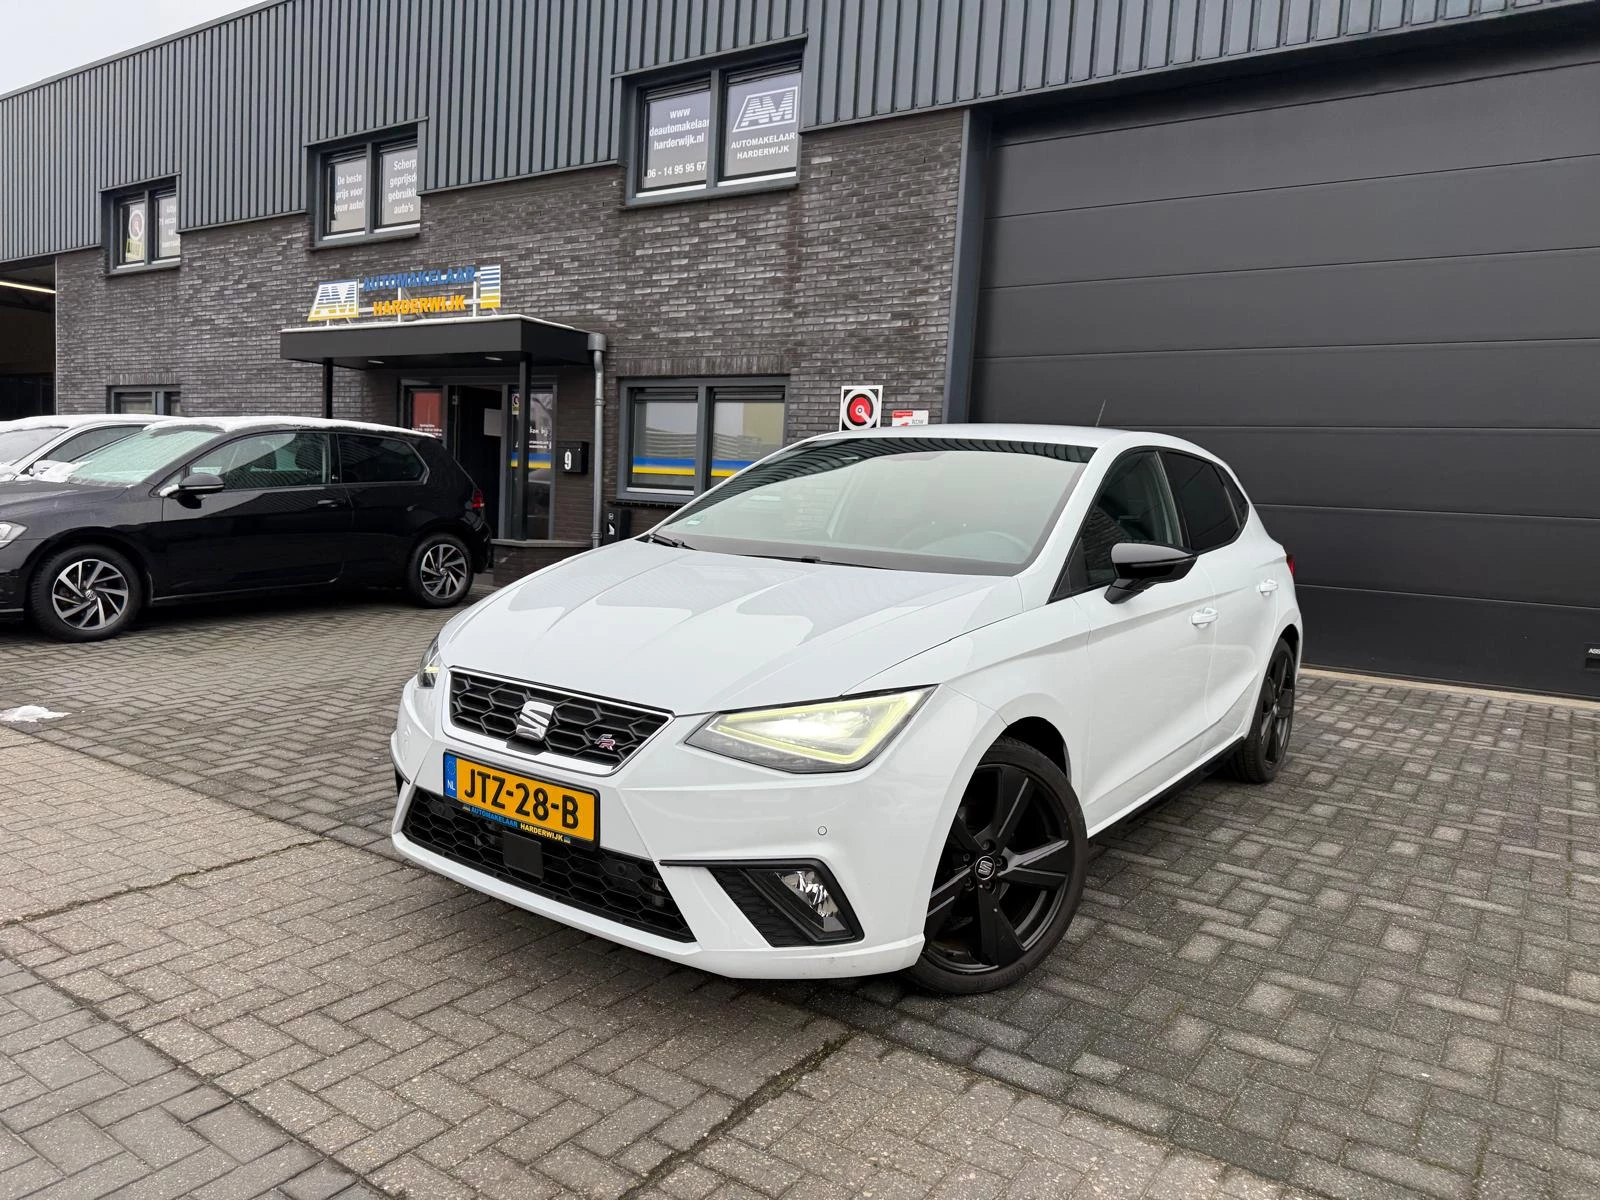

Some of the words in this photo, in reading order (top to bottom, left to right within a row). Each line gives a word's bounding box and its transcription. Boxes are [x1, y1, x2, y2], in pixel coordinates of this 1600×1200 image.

[669, 108, 691, 119] www
[649, 118, 710, 137] deautomakelaar
[653, 132, 705, 151] harderwijk.nl
[731, 132, 796, 149] AUTOMAKELAAR
[736, 145, 790, 160] HARDERWIJK
[393, 159, 417, 171] Scherp
[663, 165, 673, 176] 14
[674, 163, 684, 175] 95
[685, 162, 695, 173] 95
[696, 160, 707, 172] 67
[337, 176, 345, 185] De
[346, 173, 362, 184] beste
[390, 172, 417, 188] geprijsd
[335, 189, 349, 201] prijs
[350, 188, 364, 197] voor
[388, 187, 417, 202] gebruikt
[393, 202, 414, 214] auto's
[362, 265, 476, 292] AUTOMAKELAAR
[372, 295, 466, 317] HARDERWIJK
[564, 451, 572, 470] 9
[446, 780, 456, 791] NL
[464, 768, 579, 830] JTZ-28-B
[470, 807, 518, 828] AUTOMAKELAAR
[520, 822, 564, 842] HARDERWIJK
